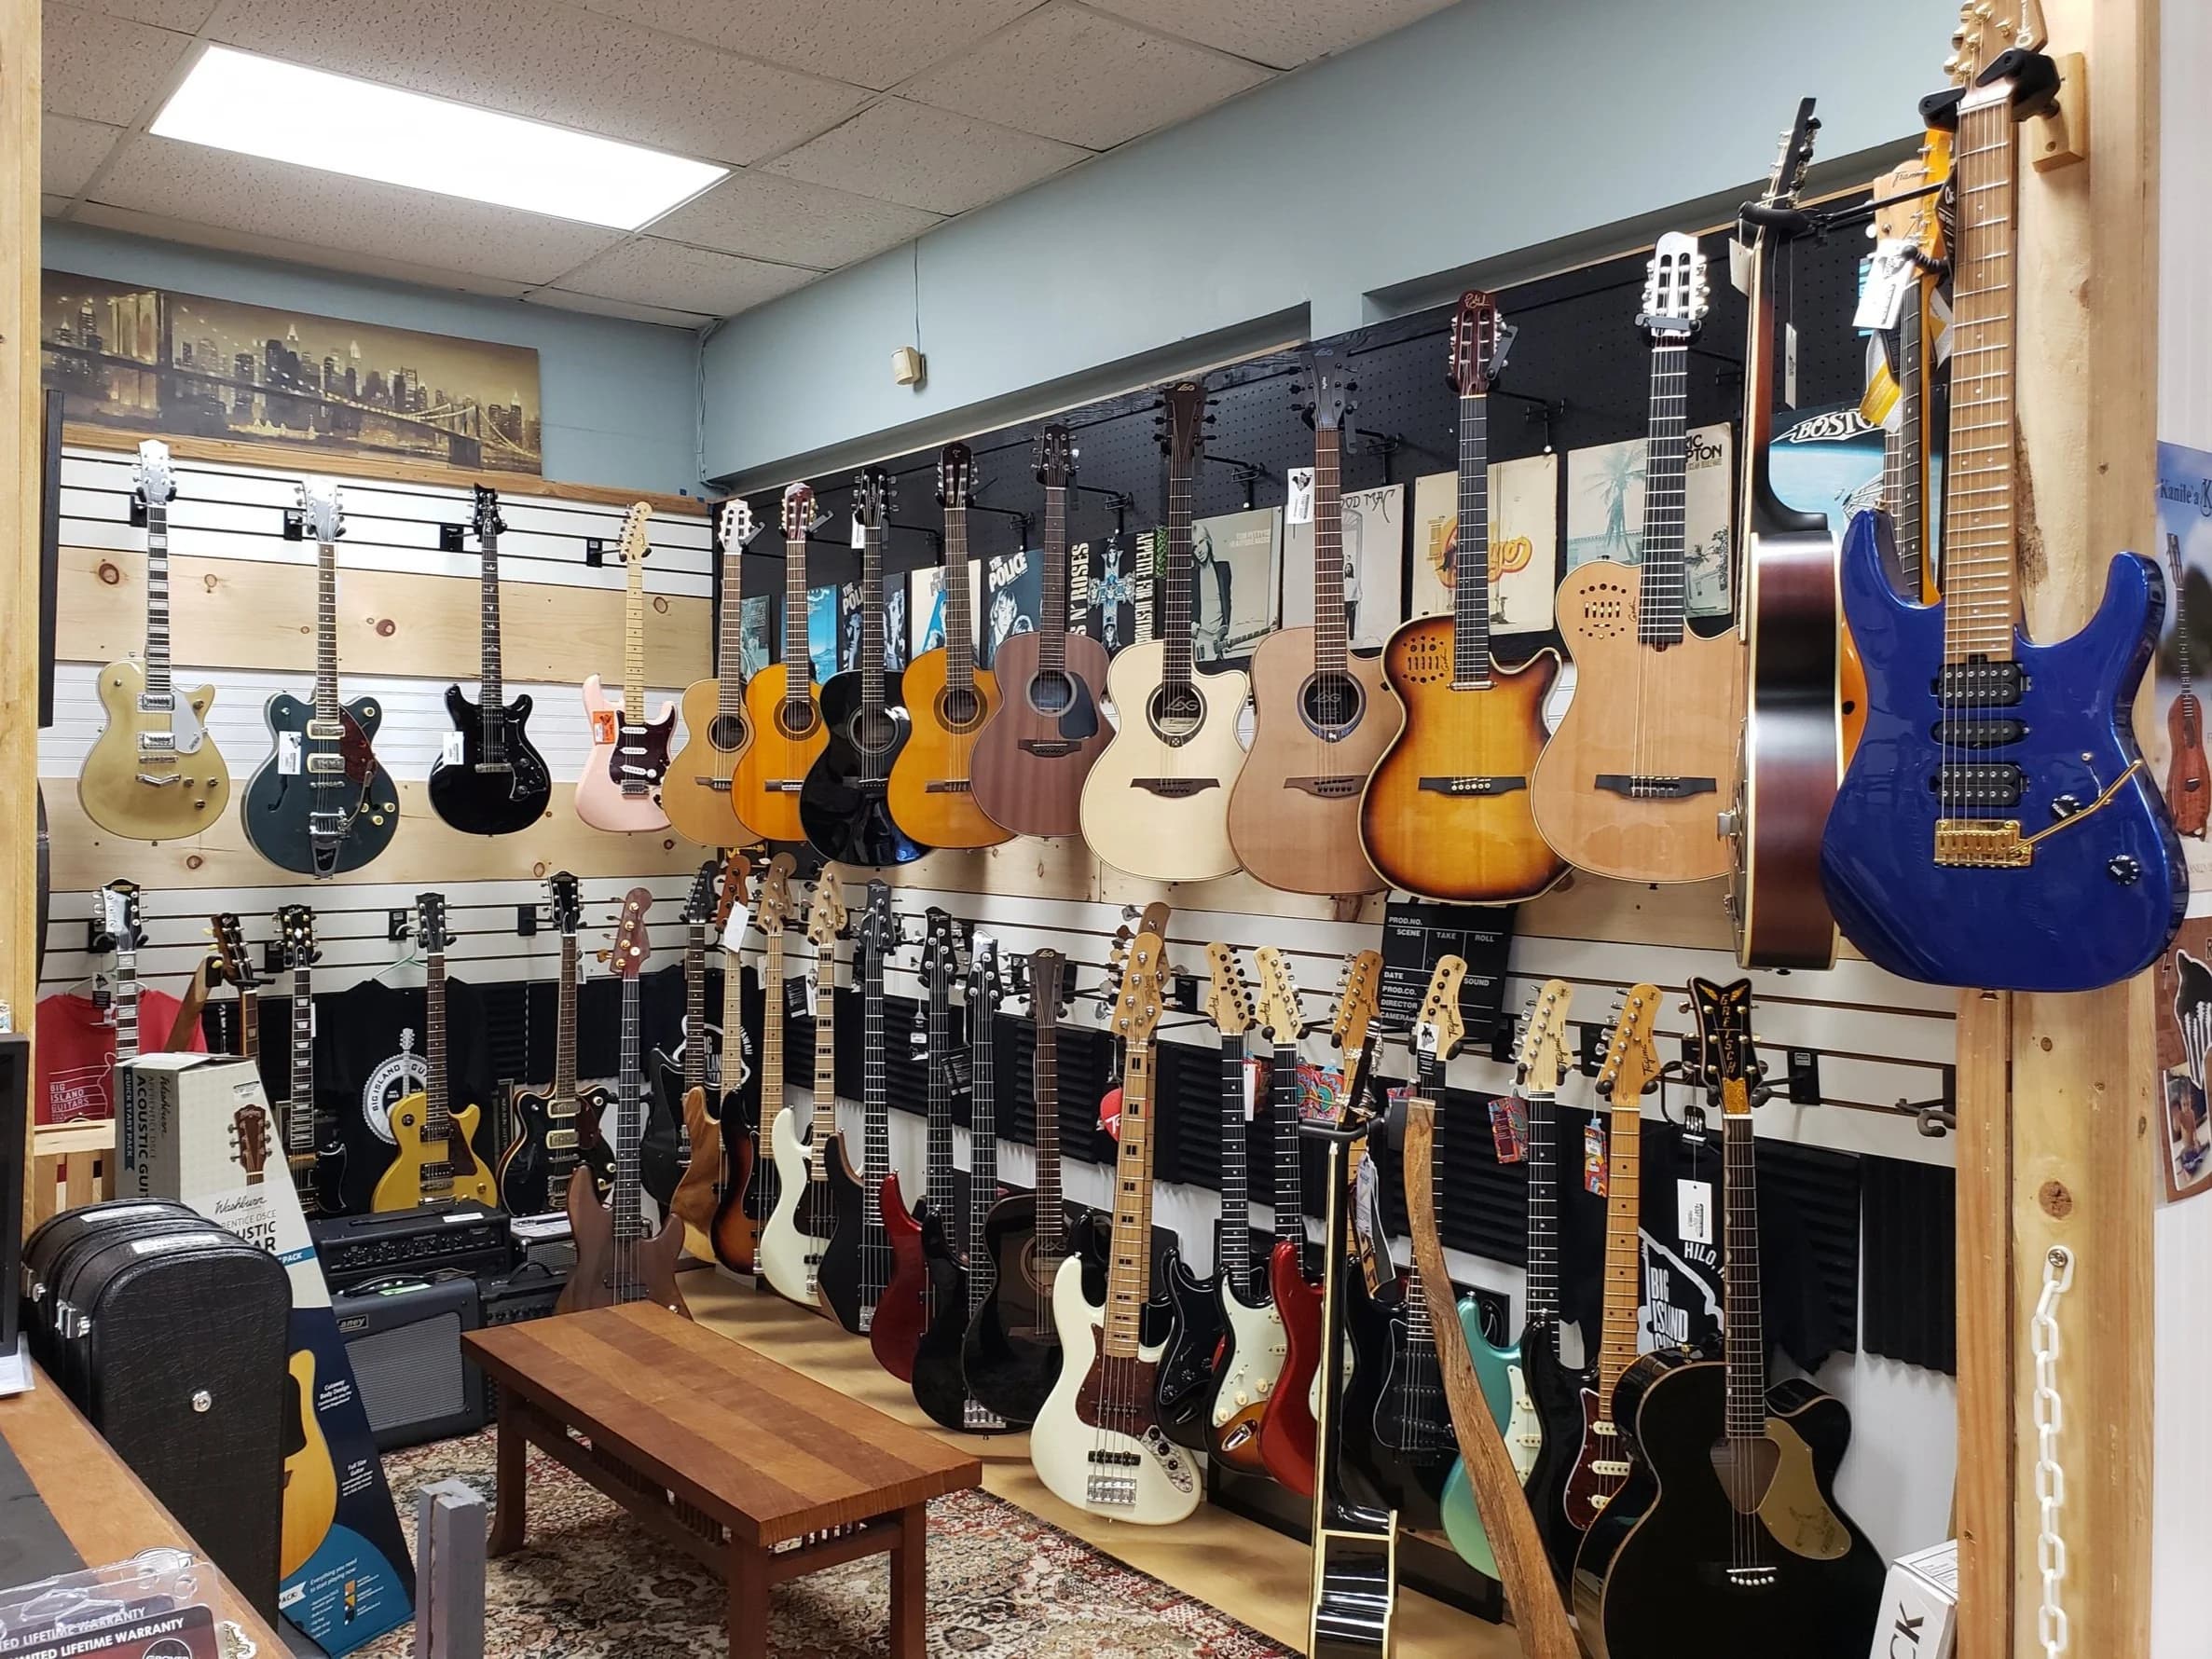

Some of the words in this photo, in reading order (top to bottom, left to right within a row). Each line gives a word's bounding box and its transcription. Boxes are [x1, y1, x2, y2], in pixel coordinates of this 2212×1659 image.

[1686, 445, 1723, 462] PTON
[989, 555, 1004, 570] THE
[1135, 531, 1155, 578] APPETITE
[988, 551, 1029, 594] POLICE
[1070, 542, 1089, 601] ROSES
[1135, 579, 1154, 600] FOR
[843, 585, 864, 616] POLI
[1396, 928, 1422, 938] SCENE
[1436, 931, 1457, 940] TAKE
[1475, 934, 1495, 943] ROLL
[1383, 971, 1405, 980] DATE
[1463, 978, 1491, 987] SOUND
[1381, 999, 1418, 1009] DIRECTOR
[1719, 994, 1738, 1073] GRETSCH
[704, 1035, 713, 1054] IG
[49, 1083, 66, 1092] BIG
[125, 1074, 133, 1101] QUICK
[375, 1063, 402, 1094] ISLAND
[50, 1089, 85, 1103] ISLAND
[51, 1097, 90, 1114] GUITARS
[137, 1076, 148, 1159] ACOUSTIC
[220, 1214, 254, 1229] RENTICE
[236, 1220, 277, 1240] USTIC
[282, 1253, 302, 1264] PACK
[1683, 1241, 1717, 1270] HILO,
[1651, 1267, 1669, 1303] BIG
[1653, 1300, 1688, 1343] ISLAND
[10, 1648, 58, 1659] MITED
[61, 1636, 113, 1657] LIFETIME
[115, 1617, 185, 1643] WARRANTY
[1889, 1599, 1924, 1659] CK
